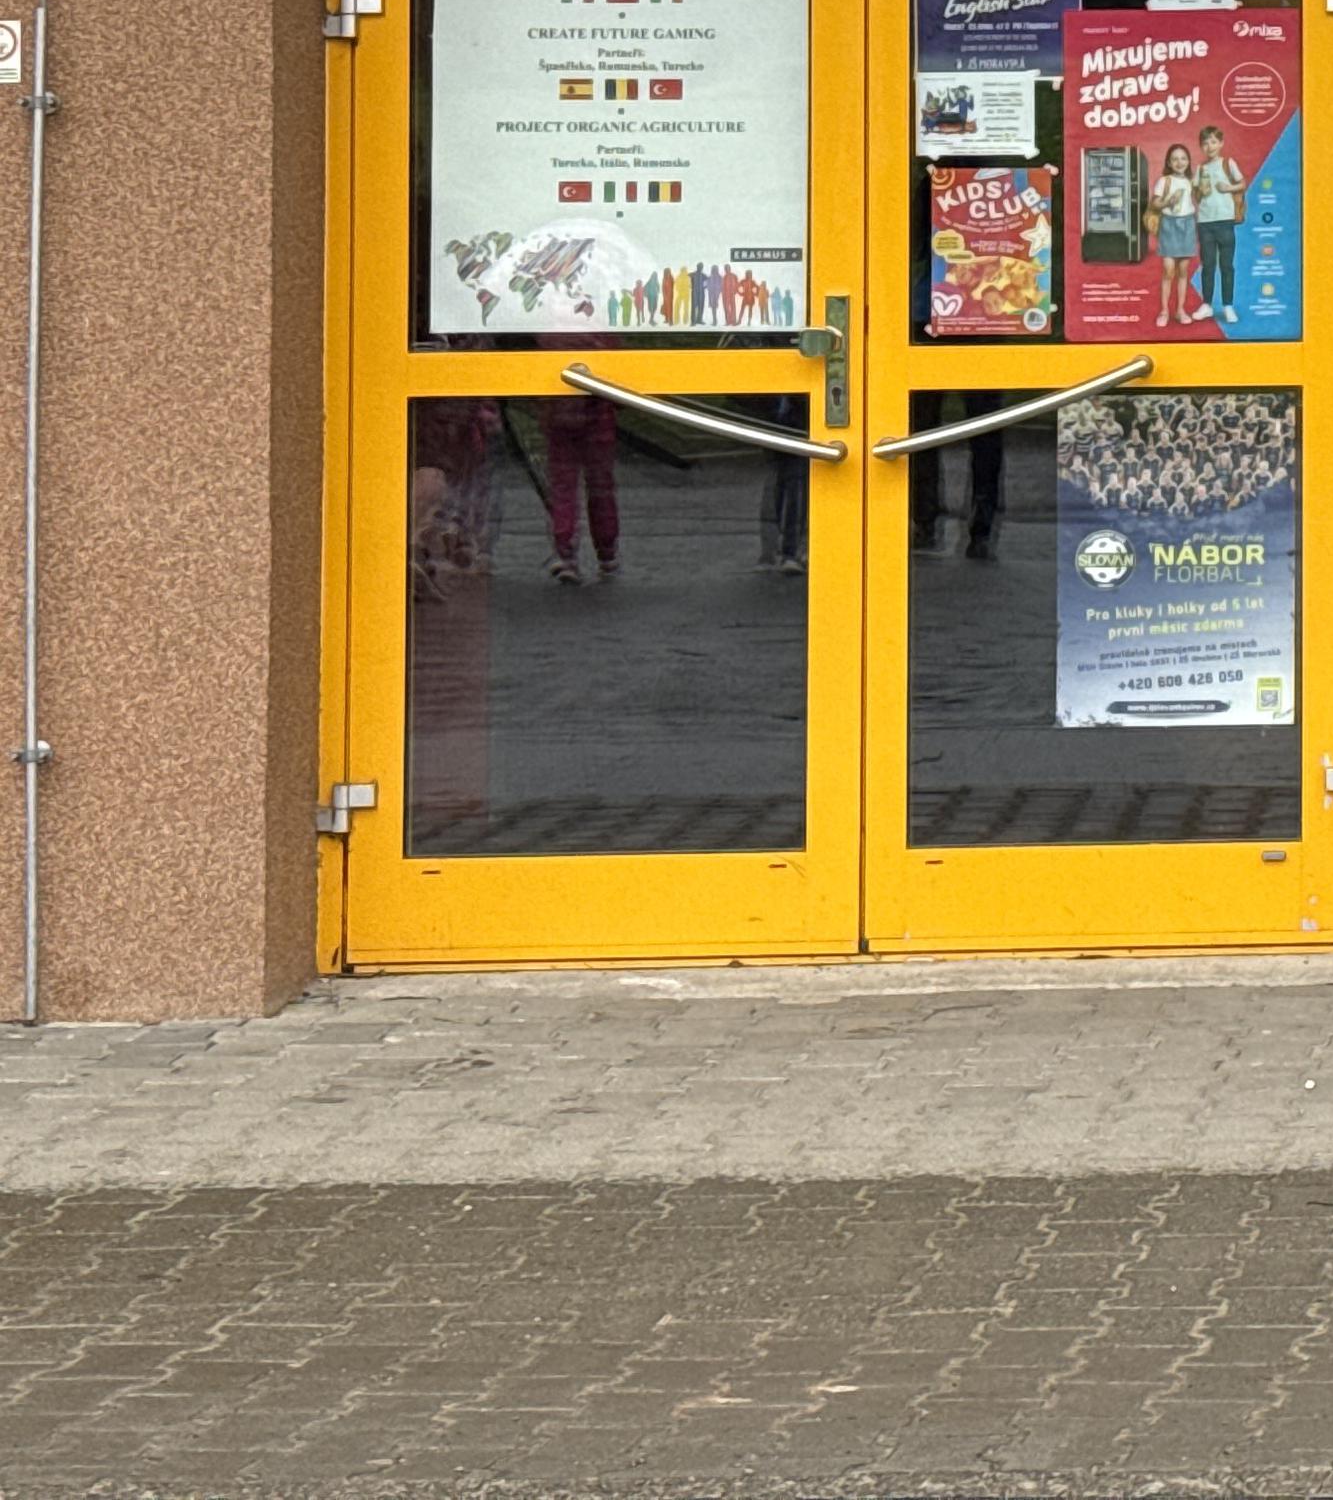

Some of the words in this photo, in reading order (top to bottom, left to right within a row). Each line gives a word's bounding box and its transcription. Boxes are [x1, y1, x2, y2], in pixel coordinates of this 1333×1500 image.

[528, 28, 587, 41] CREATE
[591, 28, 650, 41] FUTURE
[653, 28, 716, 41] GAMING
[1081, 37, 1210, 78] Mixujeme
[1079, 65, 1170, 104] zdravé
[1084, 85, 1201, 129] dobroty!
[496, 121, 563, 134] PROJECT
[566, 121, 635, 134] ORGANIC
[638, 121, 746, 134] AGRICULTURE
[969, 187, 1042, 219] CLUB
[733, 250, 788, 261] ERASMUS
[1078, 553, 1134, 568] SLOVAN
[1154, 539, 1265, 566] NÁBOR
[1155, 566, 1245, 584] FLORBAL
[1086, 609, 1110, 622] Pro
[1115, 603, 1153, 620] kluky
[1167, 600, 1205, 616] holky
[1211, 599, 1227, 612] od
[1246, 596, 1265, 610] let
[1108, 622, 1144, 640] první
[1194, 617, 1244, 632] zdarma
